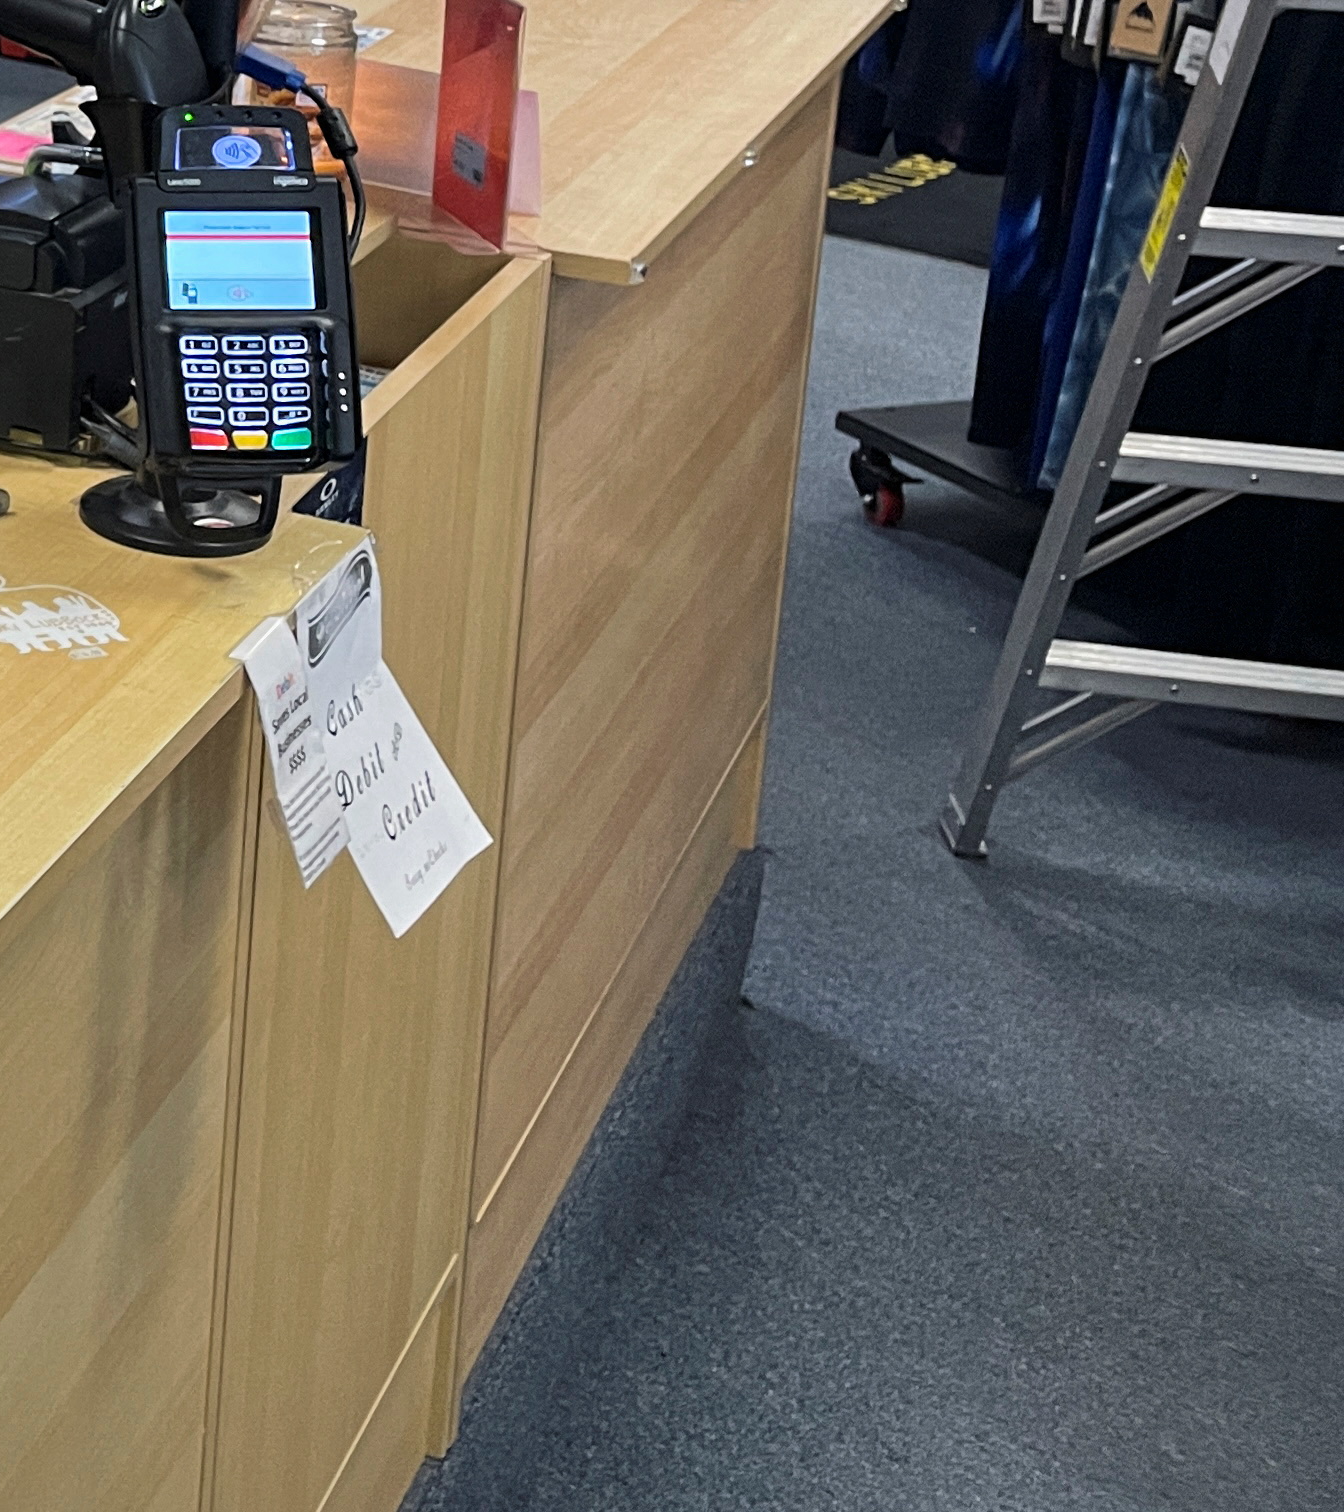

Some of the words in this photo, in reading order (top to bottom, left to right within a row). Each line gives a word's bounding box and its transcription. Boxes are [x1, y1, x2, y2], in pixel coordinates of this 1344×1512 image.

[325, 682, 364, 737] Cash
[334, 741, 385, 812] Debit
[381, 769, 437, 841] Credit
